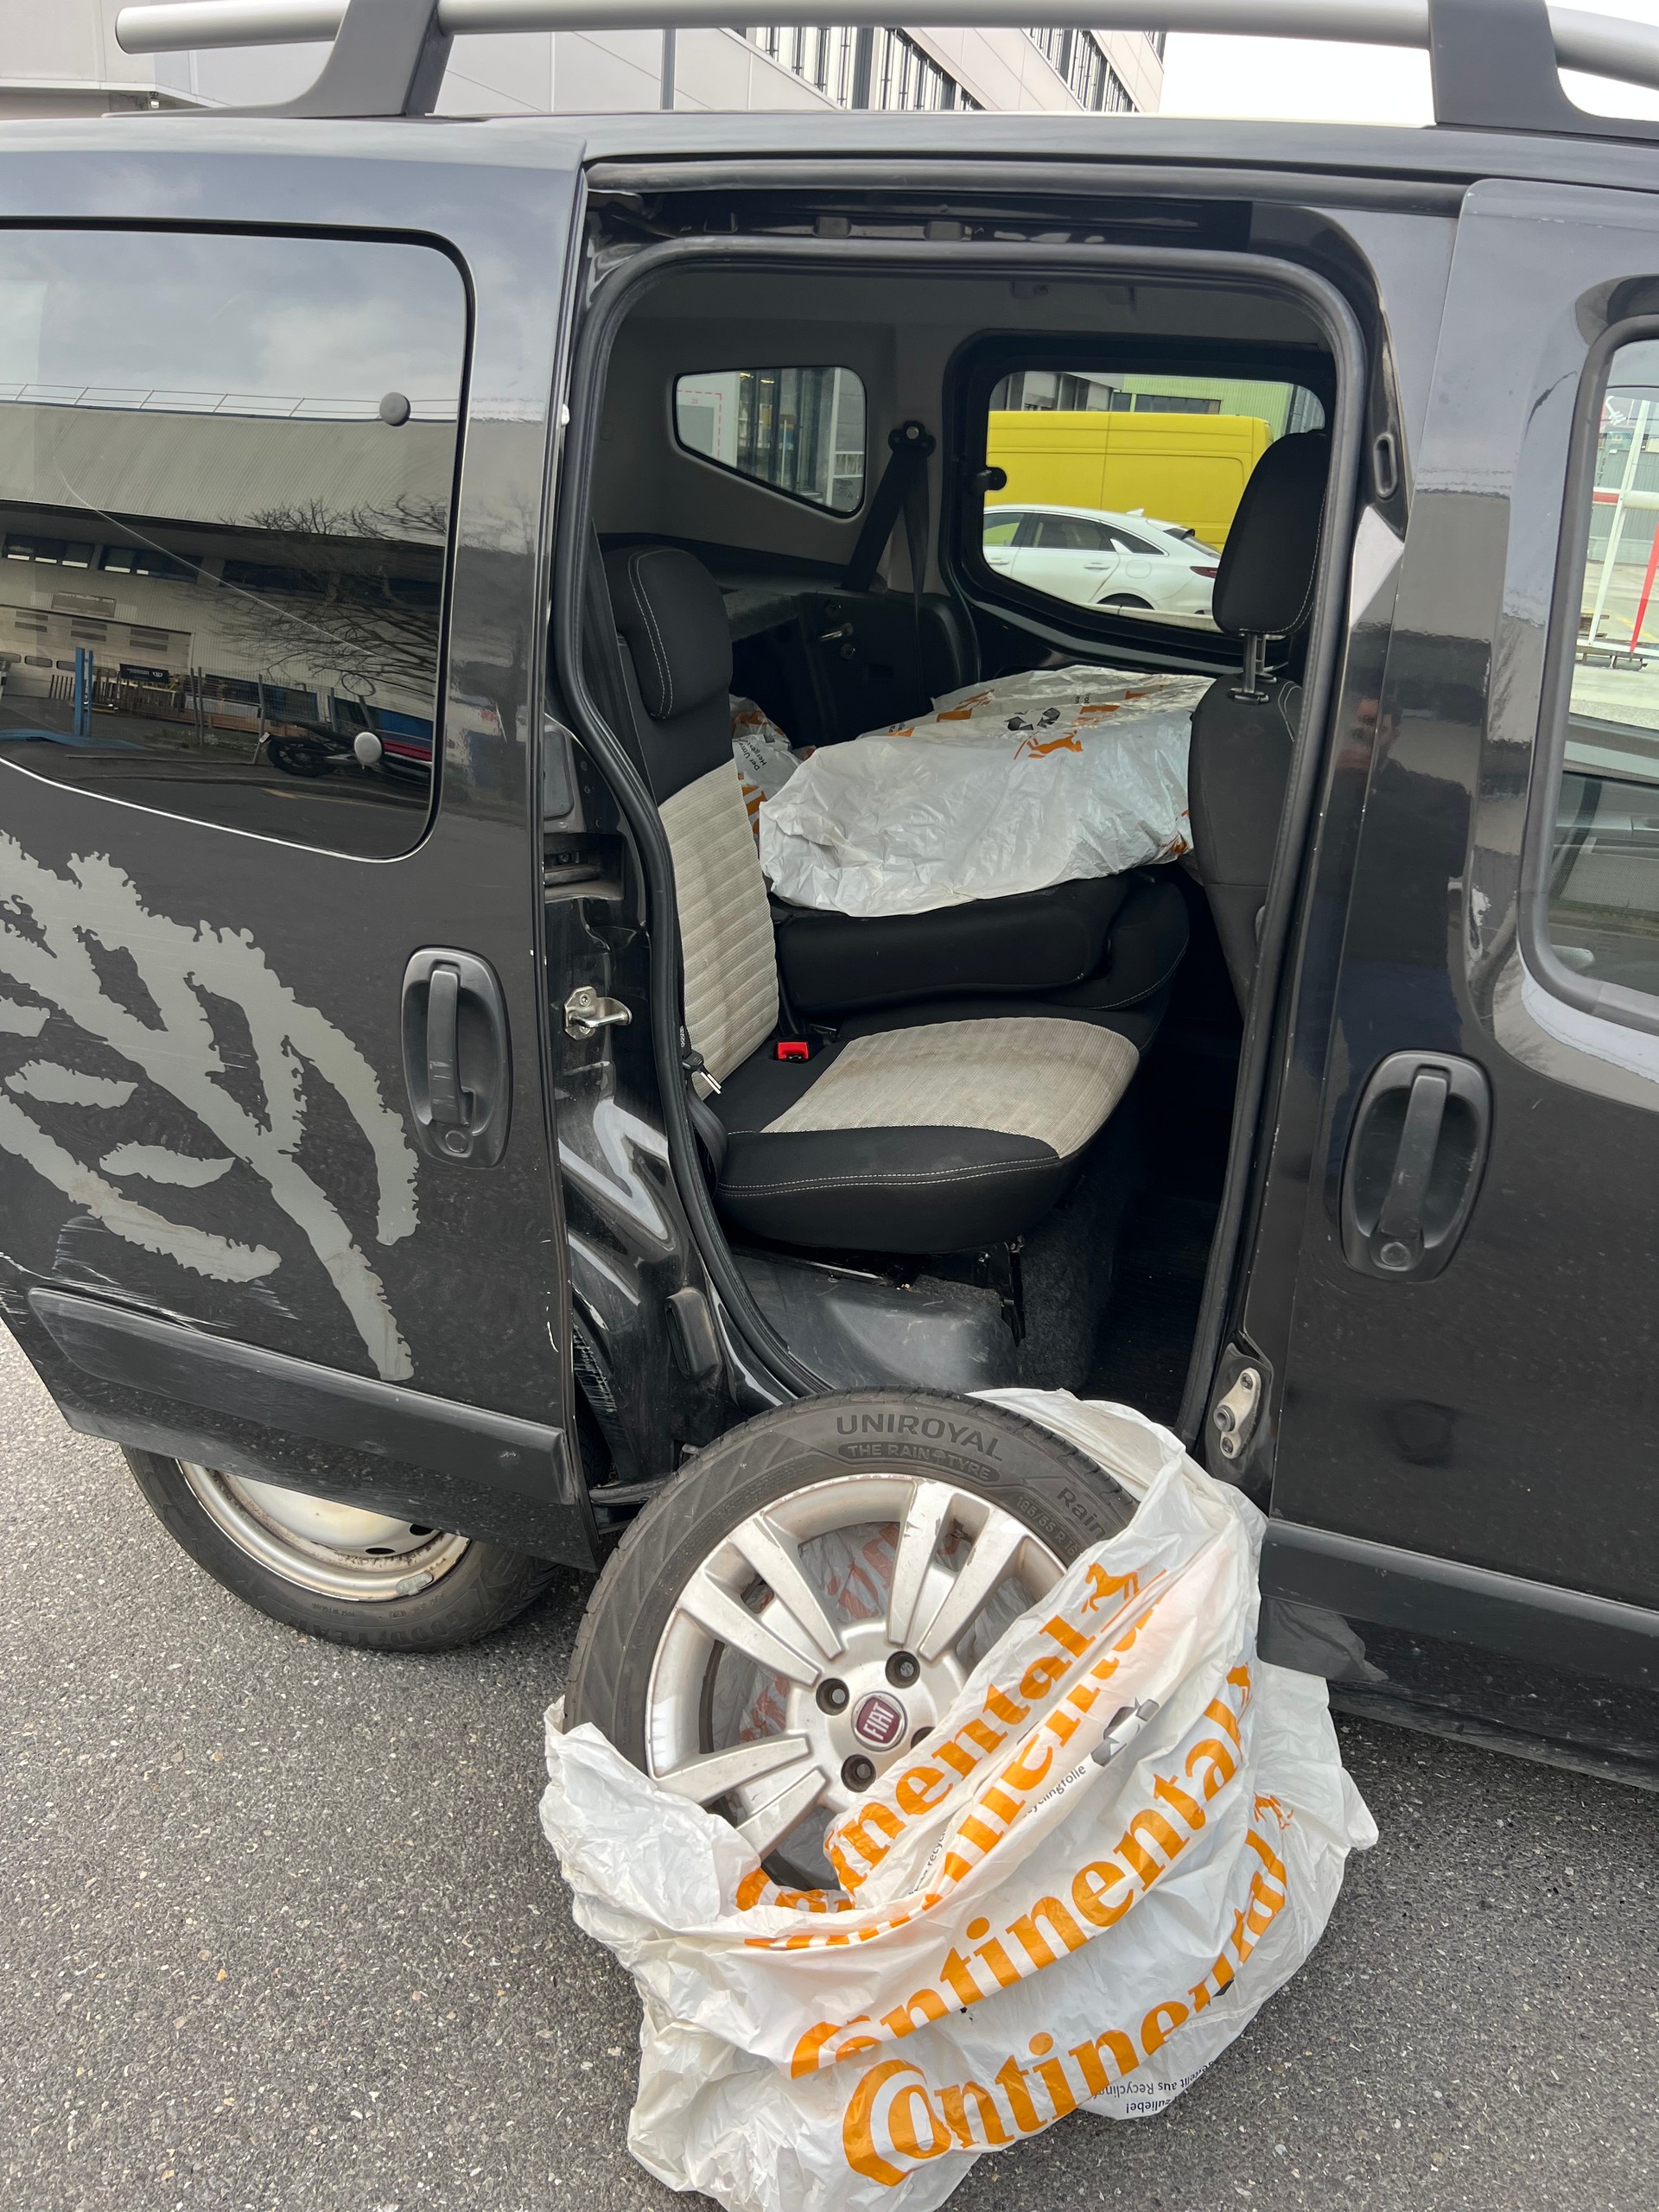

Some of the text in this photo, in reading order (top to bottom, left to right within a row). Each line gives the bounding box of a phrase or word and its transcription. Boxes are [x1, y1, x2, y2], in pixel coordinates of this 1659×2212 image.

[836, 1414, 1003, 1462] UNIROYAL
[848, 1444, 992, 1481] THE RAIN TYRE
[1057, 1486, 1106, 1541] Rain
[1055, 1530, 1065, 1543] R
[862, 1701, 894, 1741] FIAT
[1158, 2082, 1177, 2092] aus
